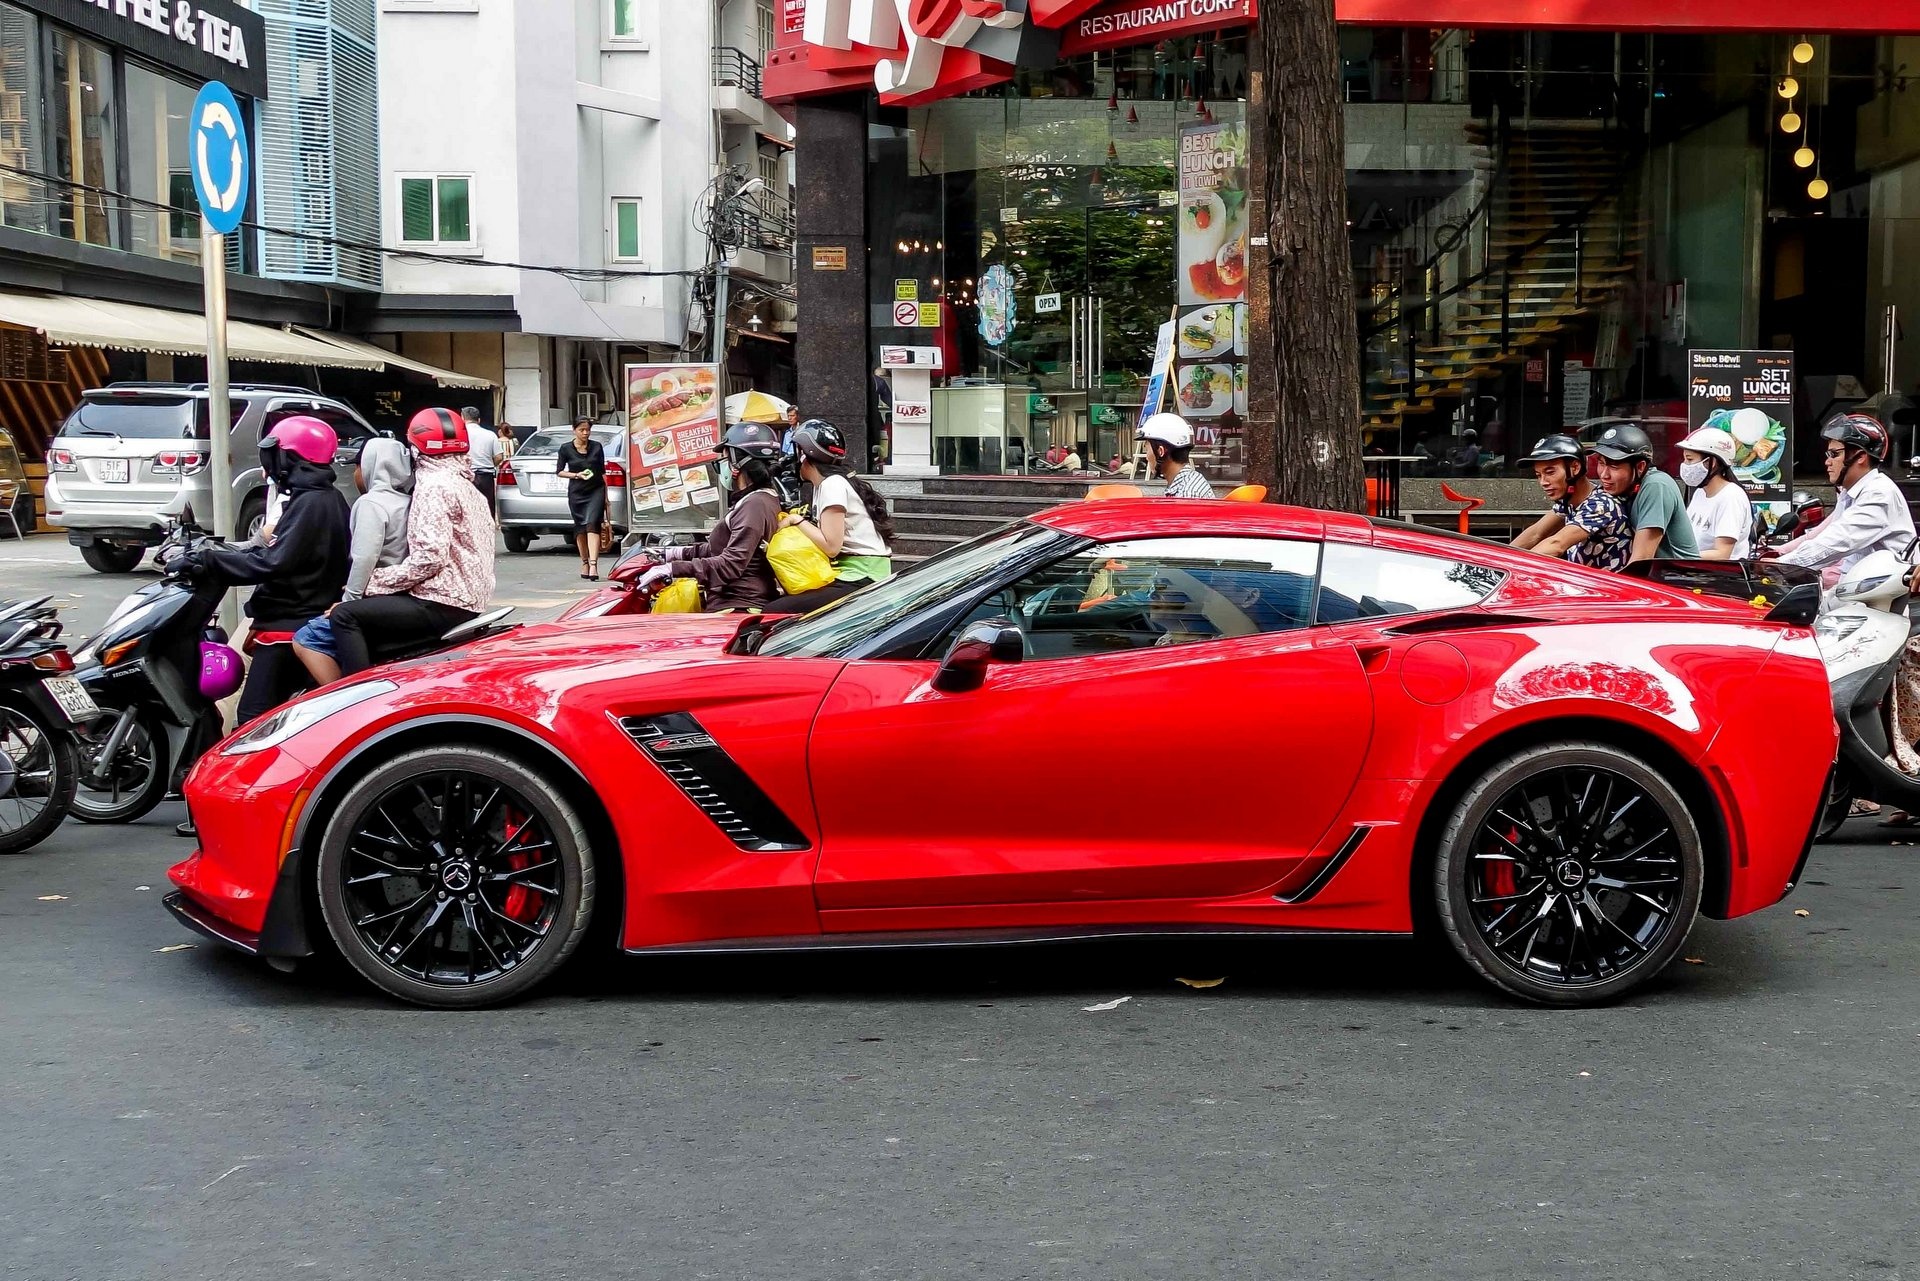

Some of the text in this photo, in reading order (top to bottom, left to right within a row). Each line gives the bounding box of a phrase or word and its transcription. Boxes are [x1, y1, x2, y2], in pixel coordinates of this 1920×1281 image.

[1080, 1, 1189, 37] RESTAURANT
[174, 0, 196, 45] &
[197, 10, 249, 69] TEA
[1182, 133, 1217, 153] BEST
[1182, 151, 1235, 173] LUNCH
[1182, 175, 1191, 189] in
[1250, 232, 1269, 246] NGUYỄ
[1038, 296, 1057, 309] OPEN
[1761, 369, 1790, 381] SET
[1691, 385, 1732, 398] 79,000
[1742, 381, 1791, 394] LUNCH
[676, 424, 713, 440] BREAKFAST
[679, 435, 717, 453] SPECIAL
[1317, 441, 1330, 463] 3
[106, 460, 121, 471] 51F
[112, 668, 141, 678] HONDA
